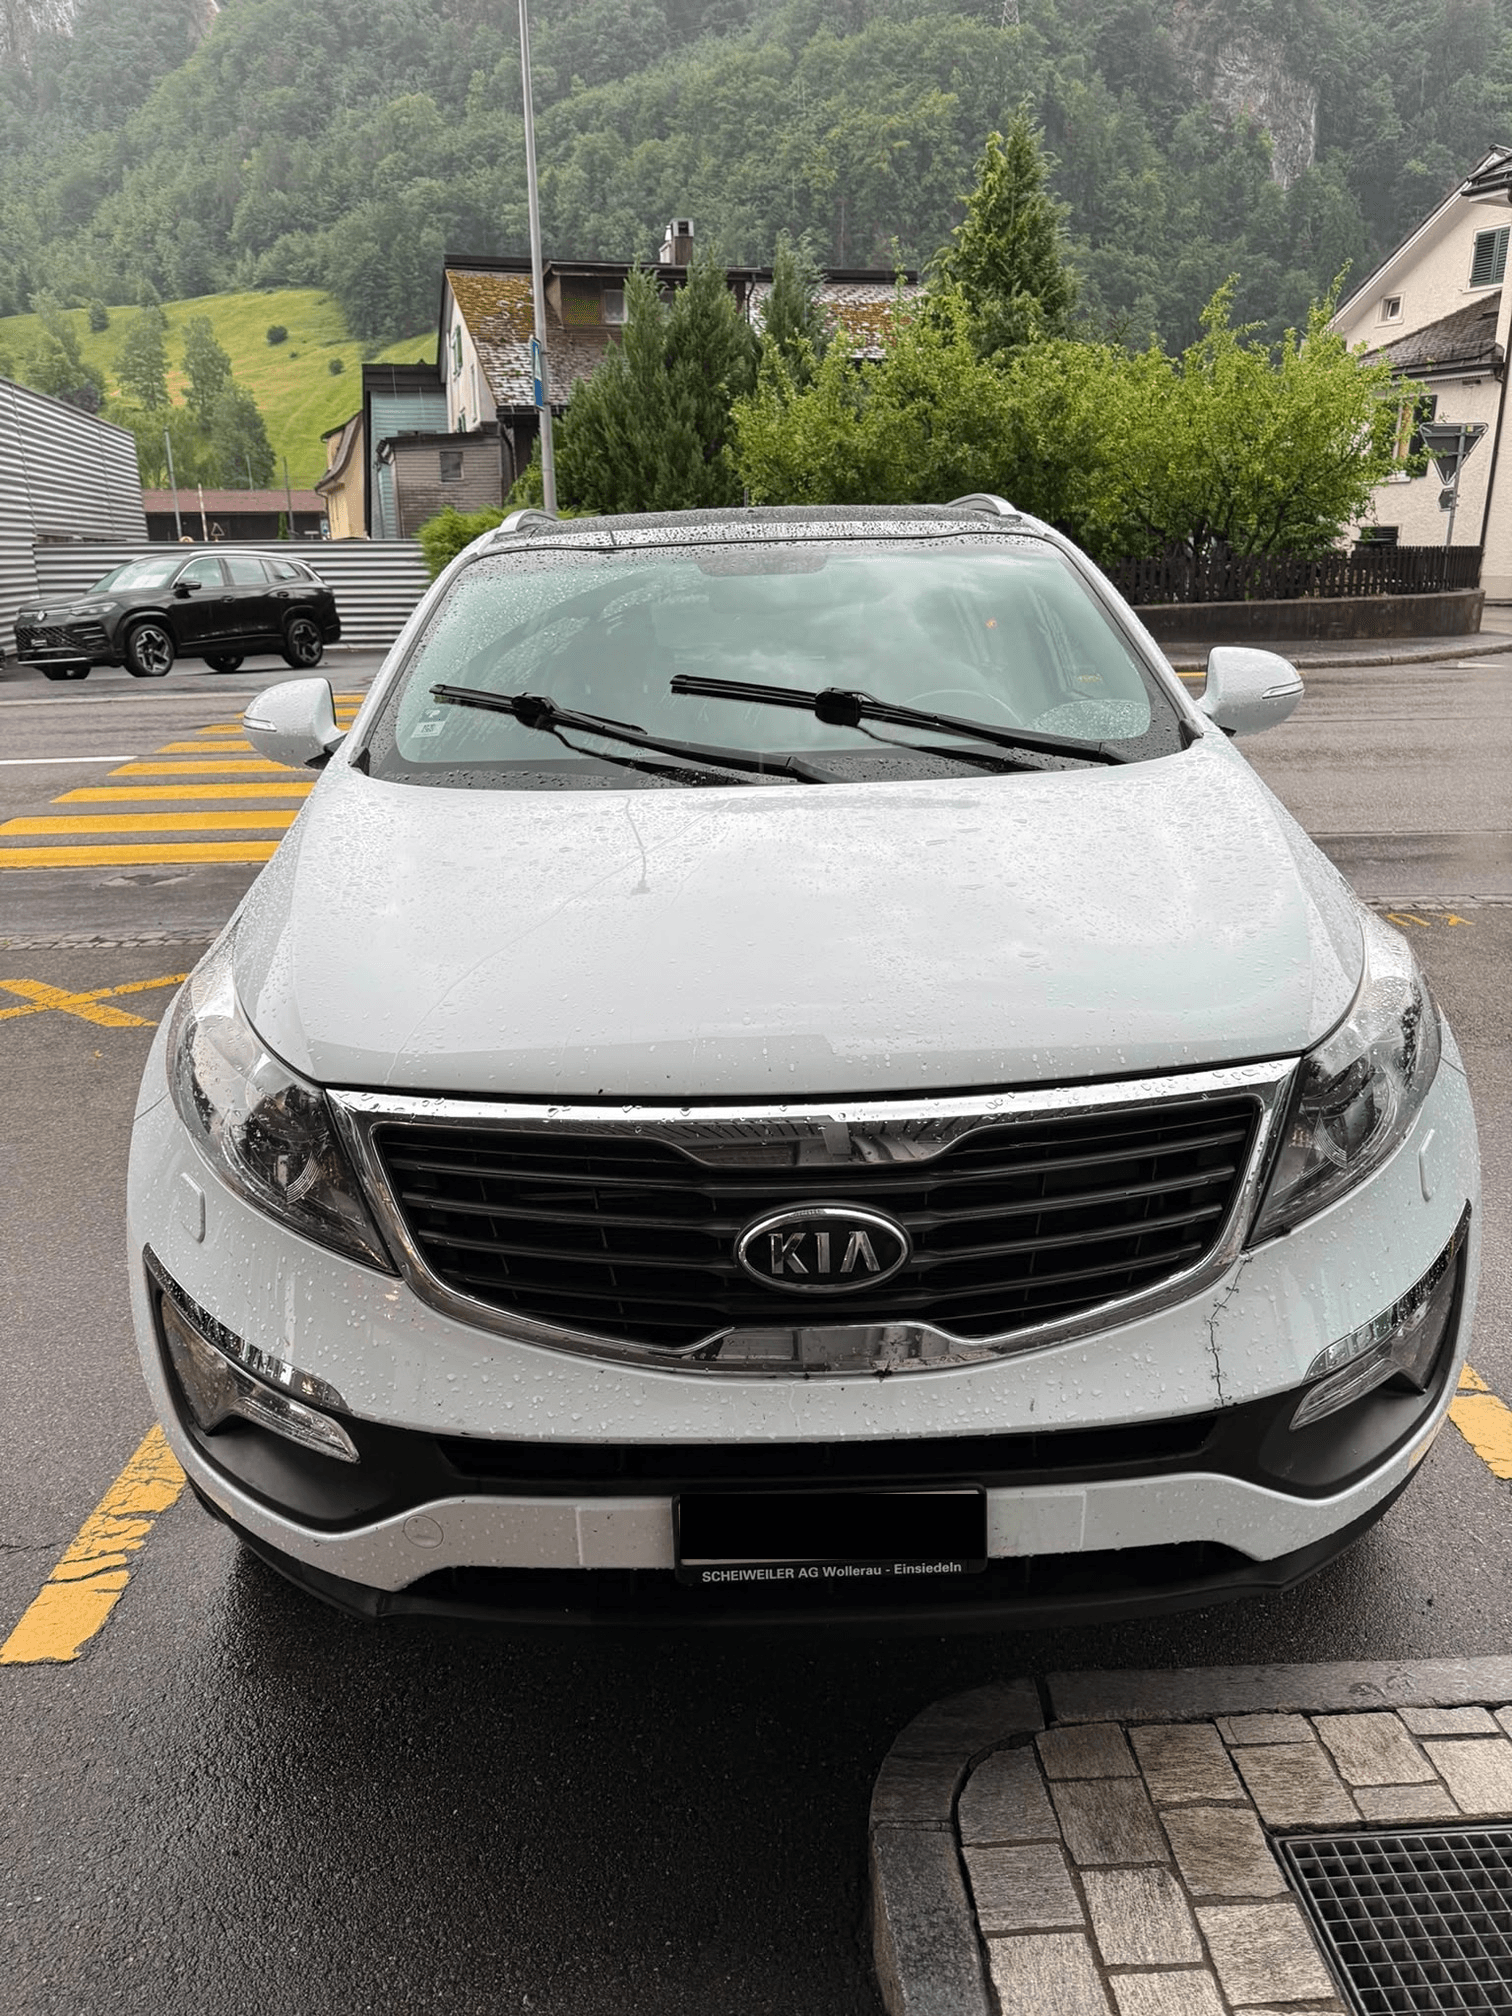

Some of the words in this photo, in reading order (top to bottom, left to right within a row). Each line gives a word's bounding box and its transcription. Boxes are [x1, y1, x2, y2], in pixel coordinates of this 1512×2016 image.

[768, 1230, 880, 1274] KIA
[702, 1568, 794, 1583] SCHEIWEILER
[798, 1567, 819, 1579] AG
[823, 1565, 882, 1578] Wollerau
[894, 1562, 962, 1575] Einsiedeln
